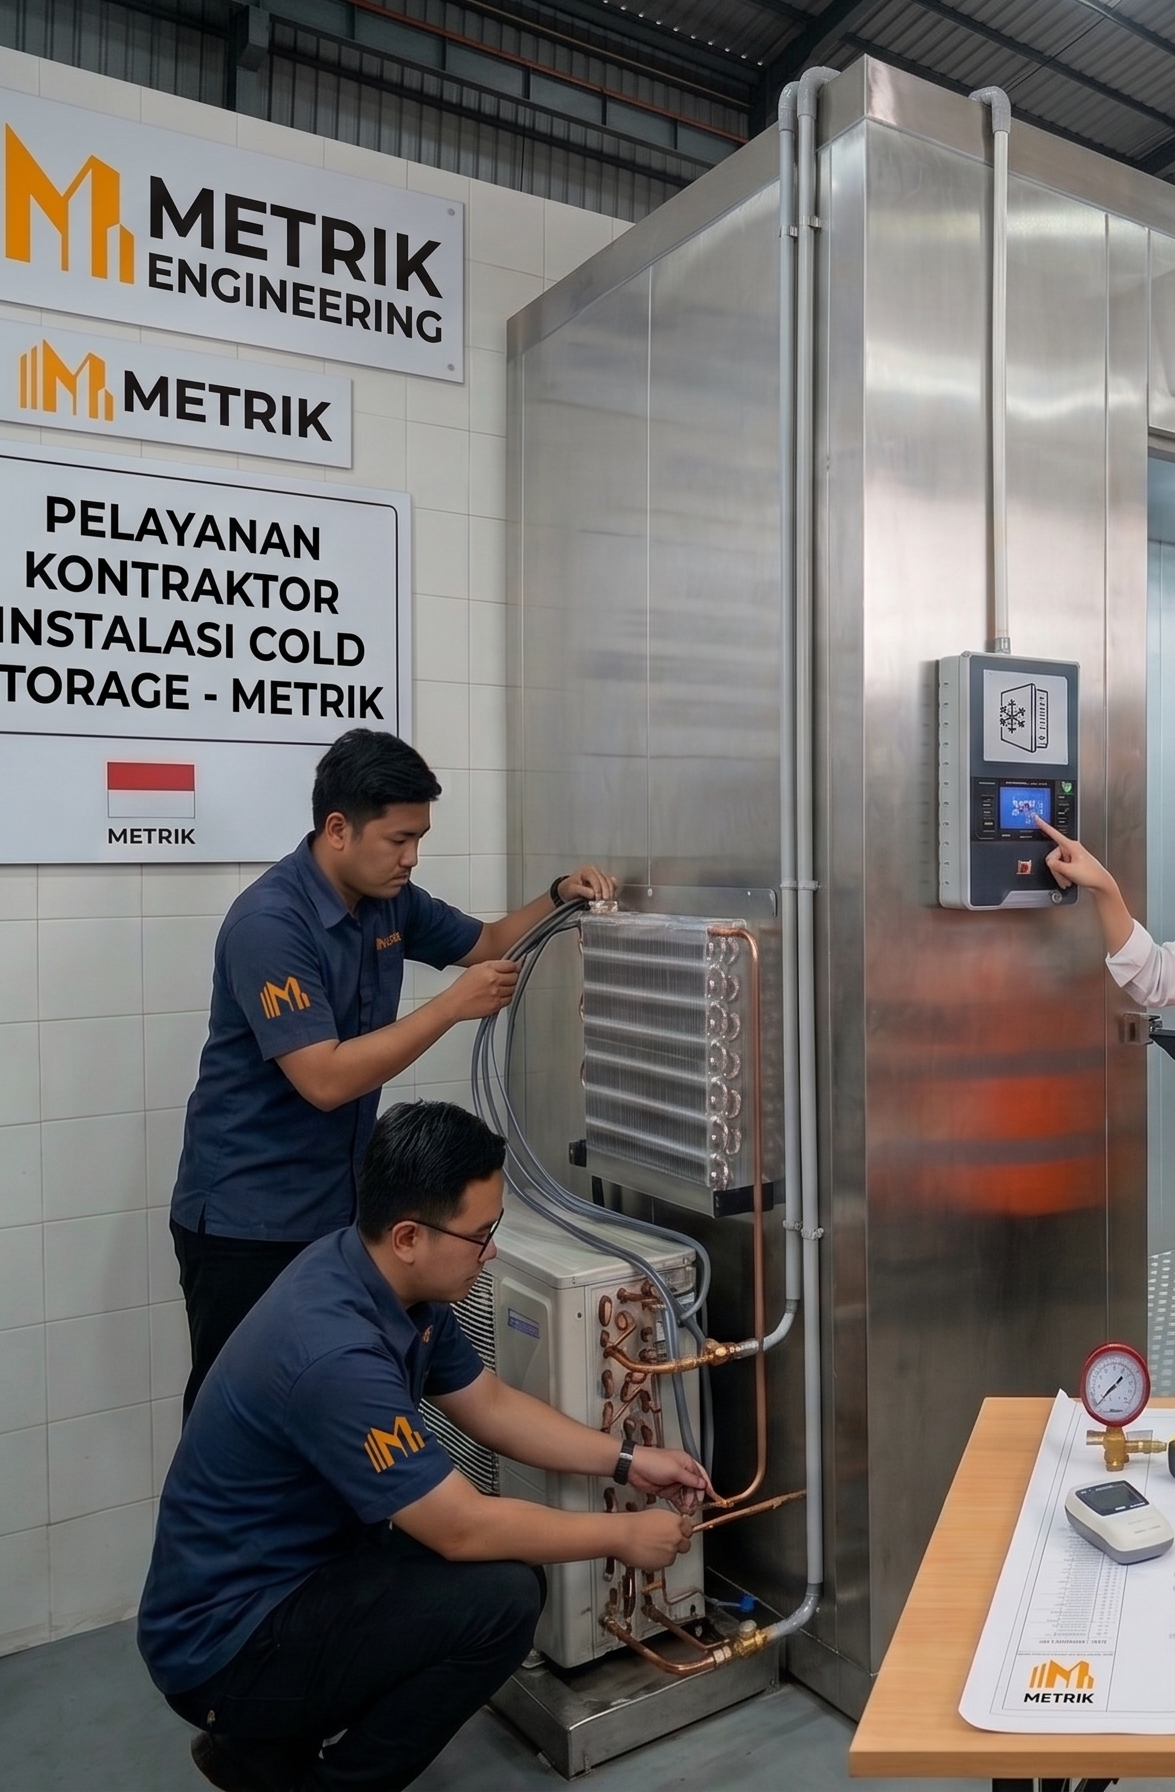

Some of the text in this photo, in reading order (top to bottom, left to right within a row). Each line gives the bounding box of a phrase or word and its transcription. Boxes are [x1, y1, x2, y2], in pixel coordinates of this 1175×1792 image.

[149, 175, 443, 299] METRIK
[148, 252, 443, 344] ENGINEERING
[124, 370, 333, 442] METRIK
[46, 495, 321, 561] PELAYANAN
[26, 551, 340, 615] KONTRAKTOR
[249, 626, 366, 667] COLD
[0, 664, 190, 711] TORAGE
[232, 677, 385, 721] METRIK
[108, 828, 196, 845] METRIK
[1023, 1693, 1095, 1704] METRIK
